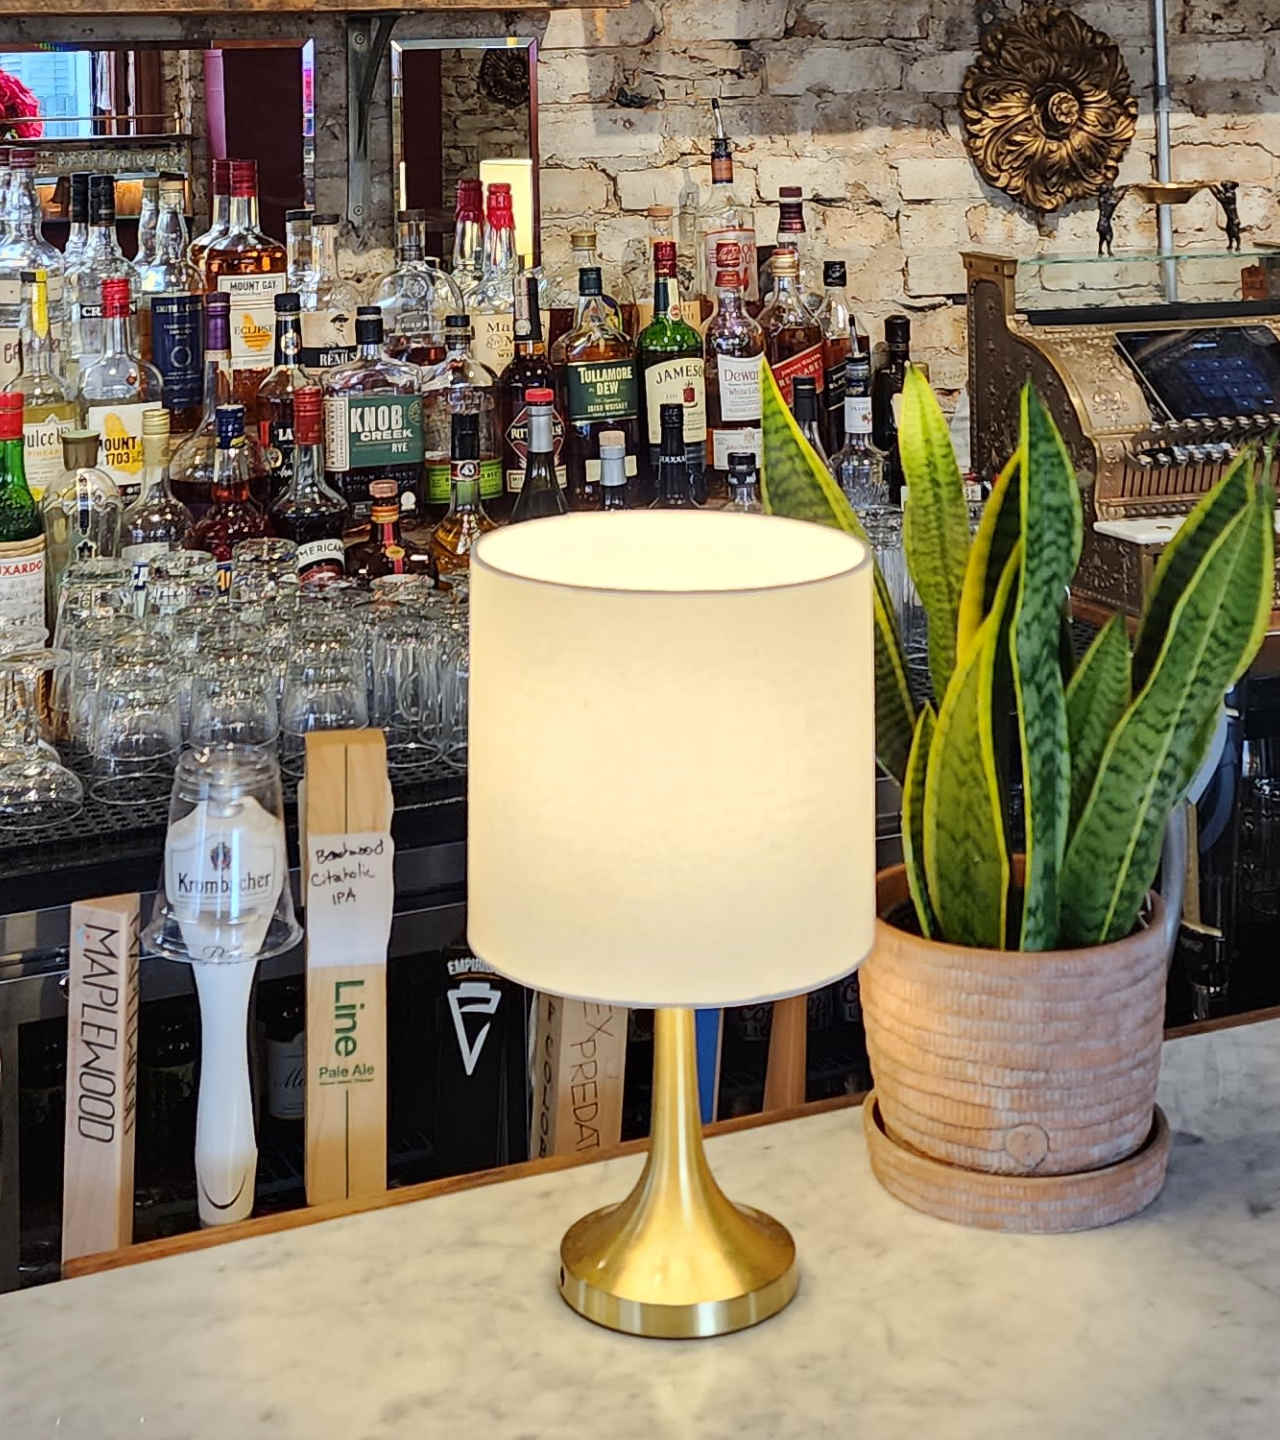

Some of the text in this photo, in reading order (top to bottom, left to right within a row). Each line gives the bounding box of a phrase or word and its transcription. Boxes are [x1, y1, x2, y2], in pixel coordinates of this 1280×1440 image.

[230, 280, 259, 291] MOUNT
[578, 366, 632, 384] TULLAMORE
[596, 381, 619, 395] DEW
[350, 404, 403, 432] KNOB
[360, 429, 413, 441] CREEK
[391, 442, 408, 453] RYE
[105, 453, 131, 465] 1703
[299, 543, 344, 559] MERICAN
[331, 888, 357, 905] IPA
[334, 979, 365, 1058] Line
[77, 923, 120, 1144] MAPLEWOOD
[319, 1066, 350, 1081] Pale
[352, 1063, 375, 1078] Ale
